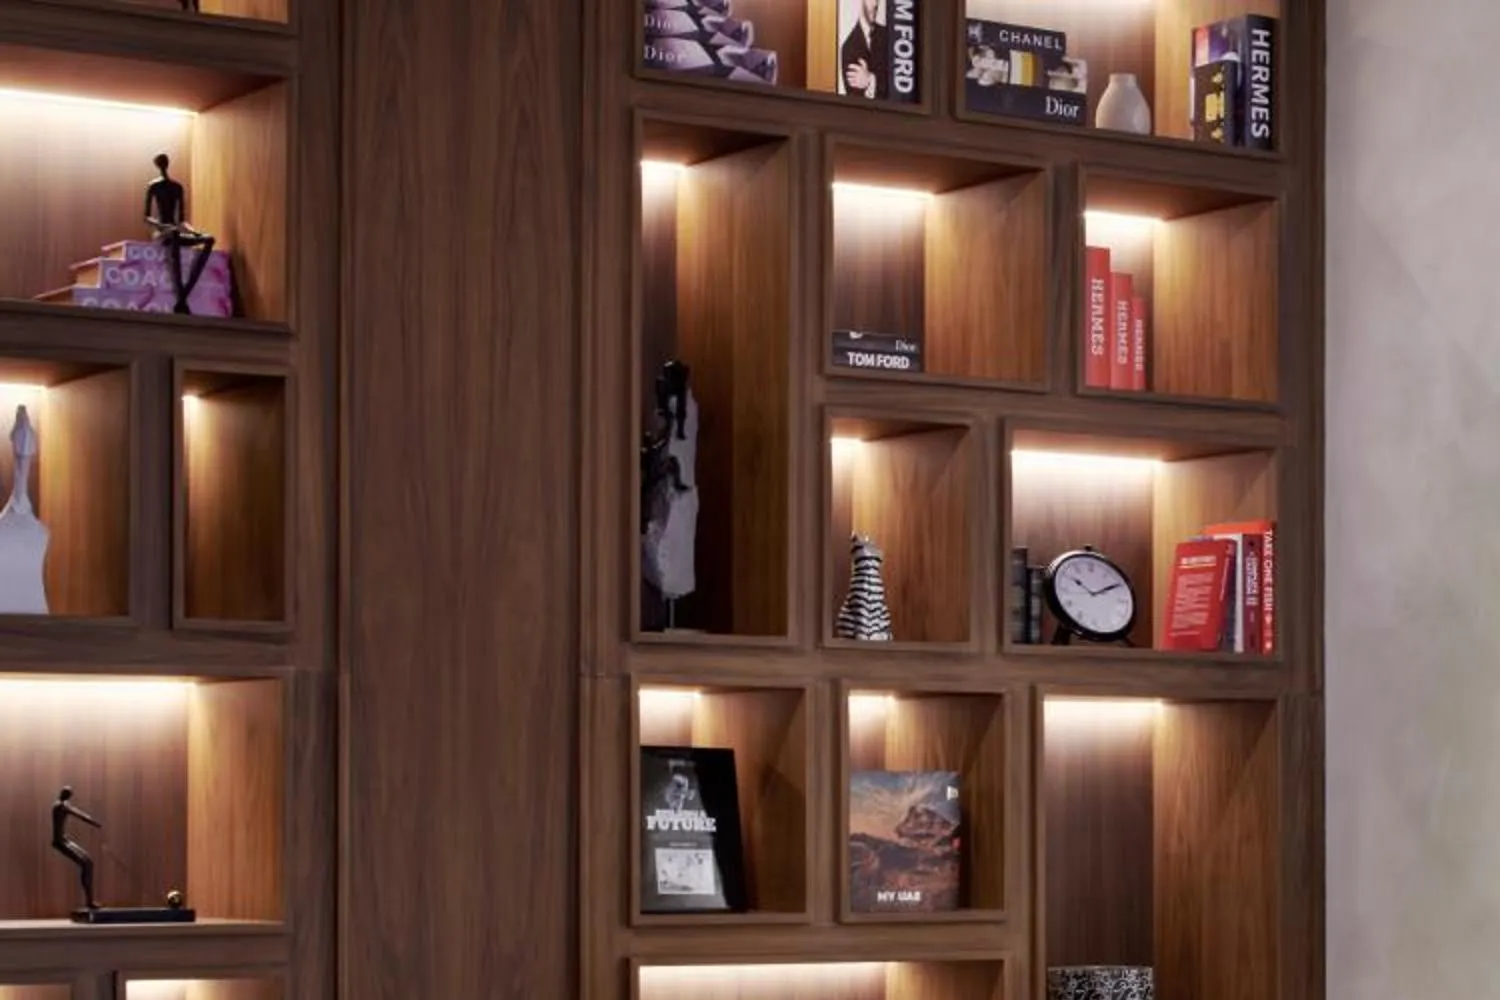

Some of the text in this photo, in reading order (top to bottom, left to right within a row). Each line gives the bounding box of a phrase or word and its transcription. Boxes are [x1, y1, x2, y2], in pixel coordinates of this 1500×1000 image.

[999, 29, 1063, 50] CHANEL
[894, 24, 914, 93] FORD
[1251, 28, 1271, 138] HERMES
[1045, 95, 1080, 118] Dior
[847, 351, 911, 370] TOM FORD
[1262, 529, 1273, 611] TAKE ONE FISH
[646, 815, 717, 832] FUTURE
